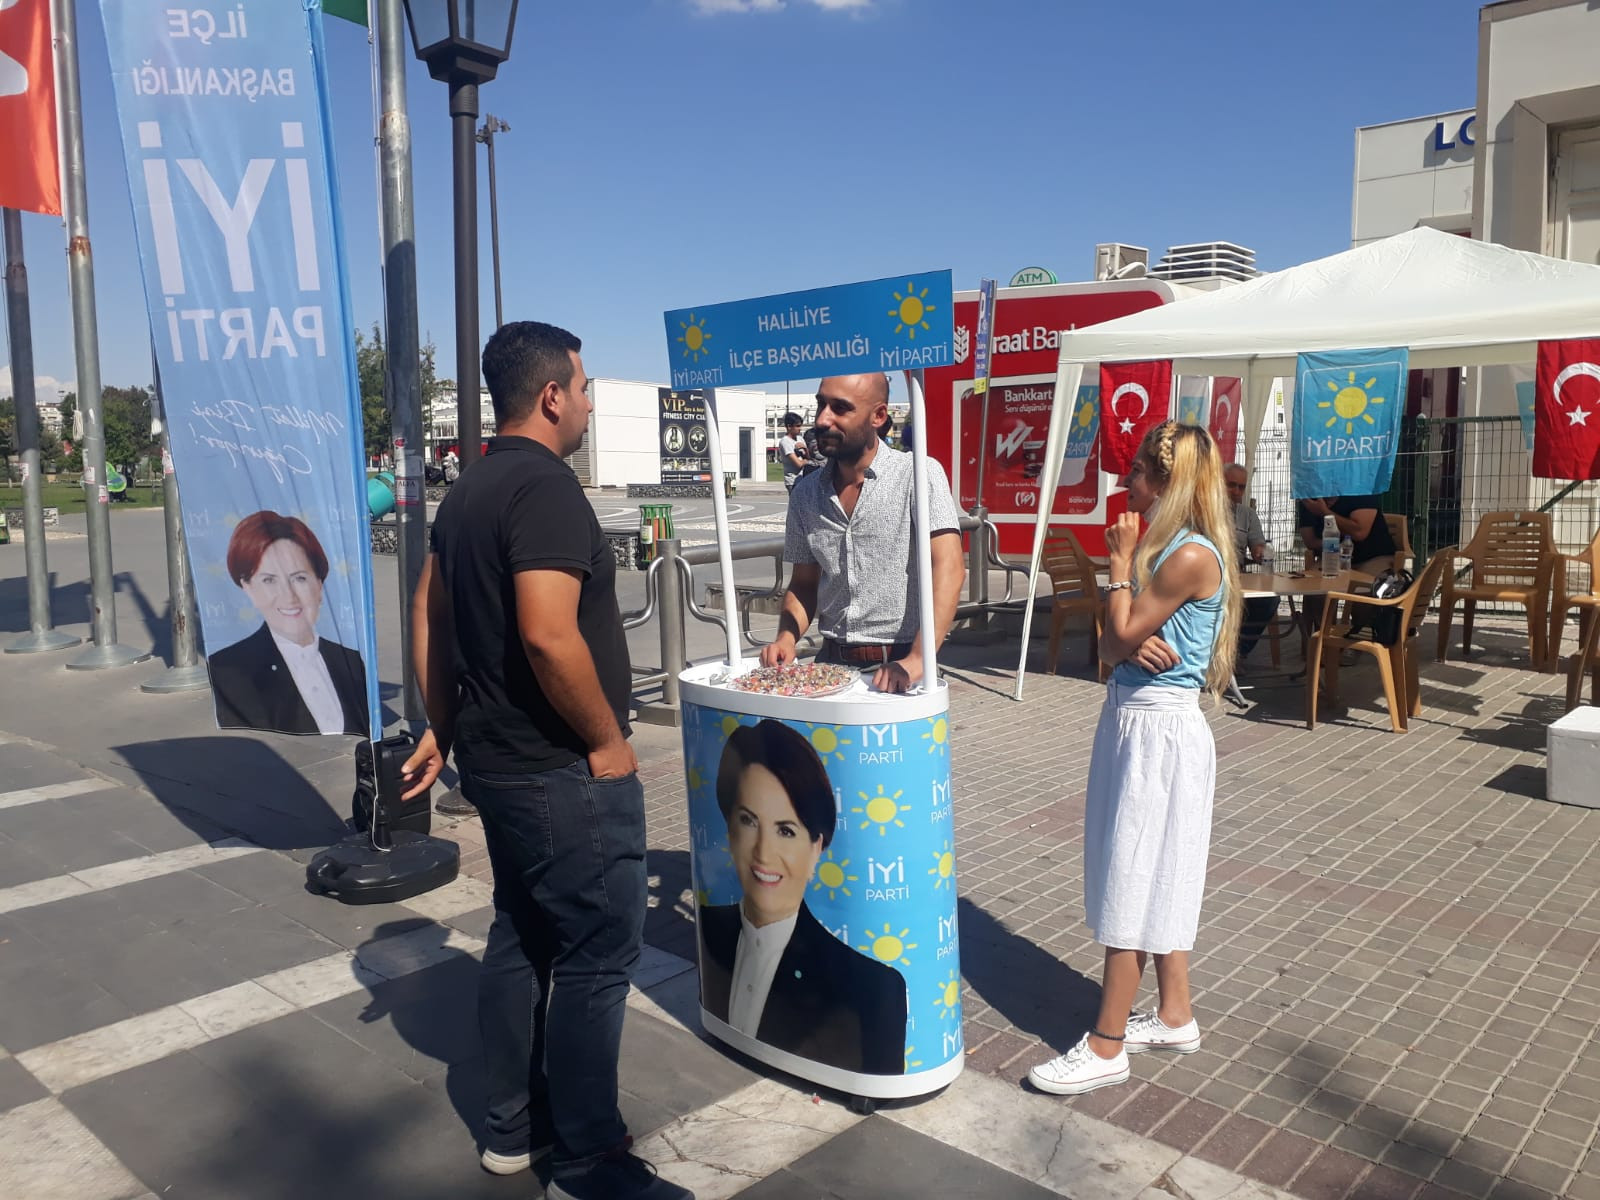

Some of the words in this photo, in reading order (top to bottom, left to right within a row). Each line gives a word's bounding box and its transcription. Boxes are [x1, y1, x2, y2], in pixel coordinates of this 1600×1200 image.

[1017, 272, 1044, 284] ATM
[757, 306, 832, 333] HALİLİYE
[991, 328, 1030, 354] raat
[729, 348, 765, 371] İLÇE
[767, 334, 869, 369] BAŞKANLIĞI
[1004, 387, 1053, 402] Bankkart
[662, 398, 686, 411] VIP
[858, 747, 904, 764] PARTİ
[867, 855, 905, 885] İYİ
[865, 886, 909, 901] PARTİ
